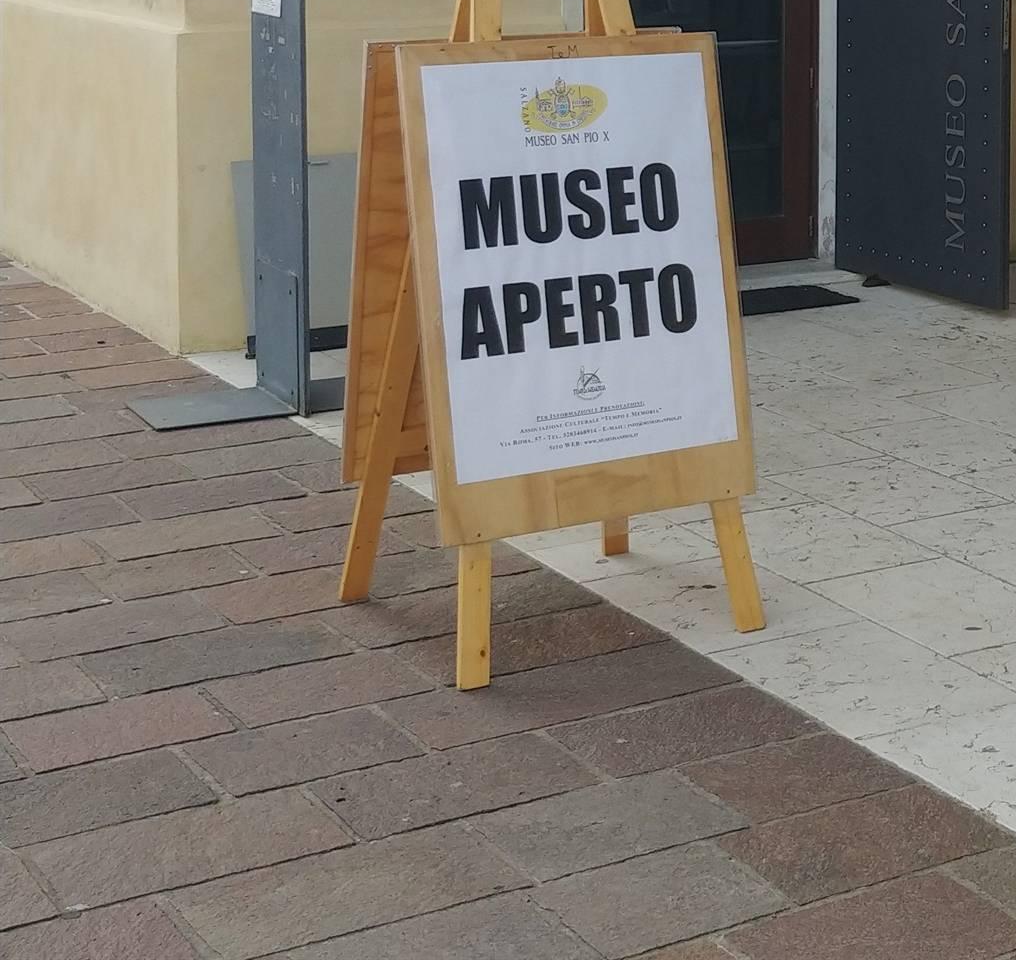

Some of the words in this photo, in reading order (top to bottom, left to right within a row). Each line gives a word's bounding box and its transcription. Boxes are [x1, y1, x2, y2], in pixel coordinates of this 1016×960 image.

[520, 87, 531, 133] SALZANO
[525, 134, 557, 147] MUSEO
[561, 132, 580, 145] SAN
[584, 131, 599, 143] PIO
[603, 130, 610, 142] X
[459, 162, 680, 250] MUSEO
[945, 74, 967, 251] MUSEO
[461, 263, 698, 361] APERTO
